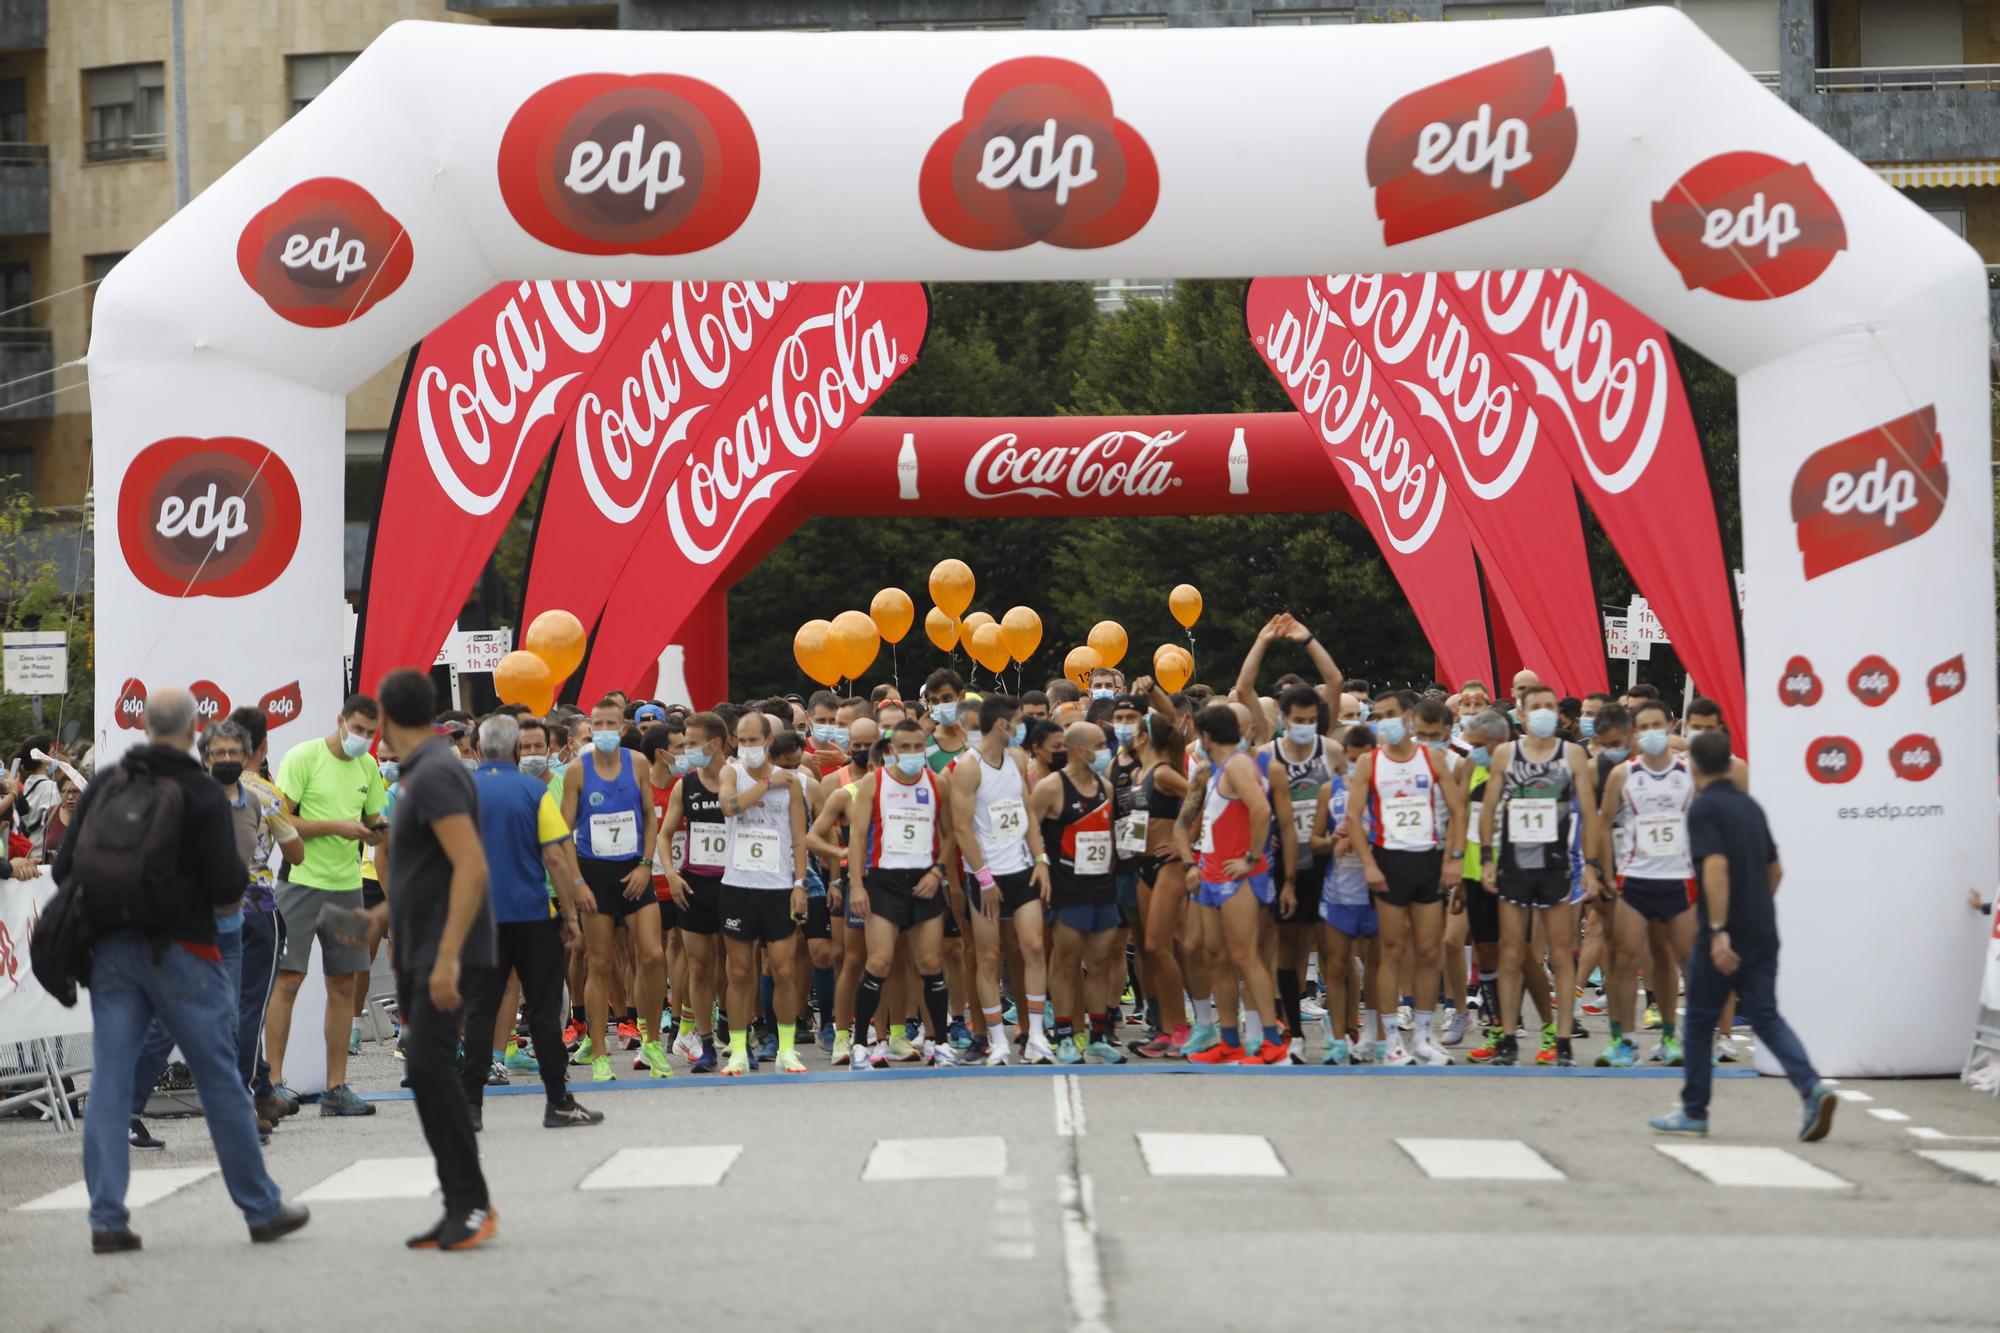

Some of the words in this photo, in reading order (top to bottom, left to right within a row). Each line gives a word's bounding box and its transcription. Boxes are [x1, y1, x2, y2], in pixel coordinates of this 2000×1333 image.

[1413, 104, 1533, 188] edp
[564, 124, 686, 211] edp
[976, 119, 1098, 205] edp
[1702, 193, 1801, 257] edp
[280, 227, 366, 282] edp
[665, 280, 899, 565] Coca-Cola
[965, 431, 1187, 498] Coca-Cola
[1823, 459, 1918, 527] edp
[156, 483, 248, 551] edp
[466, 644, 480, 654] 1h
[467, 659, 480, 668] 1h
[1786, 674, 1811, 694] edp
[1858, 672, 1888, 693] edp
[1936, 670, 1960, 689] edp
[123, 696, 144, 717] edp
[268, 696, 294, 717] edp
[1818, 750, 1847, 770] edp
[1902, 748, 1930, 768] edp
[1000, 812, 1019, 829] 24
[1396, 811, 1421, 827] 22
[1520, 813, 1544, 828] 11
[1838, 803, 1944, 820] es.edp.com
[609, 827, 620, 843] 7
[903, 824, 915, 840] 5
[1648, 827, 1674, 843] 15
[702, 836, 726, 853] 10
[751, 843, 763, 858] 6
[1087, 846, 1106, 861] 29
